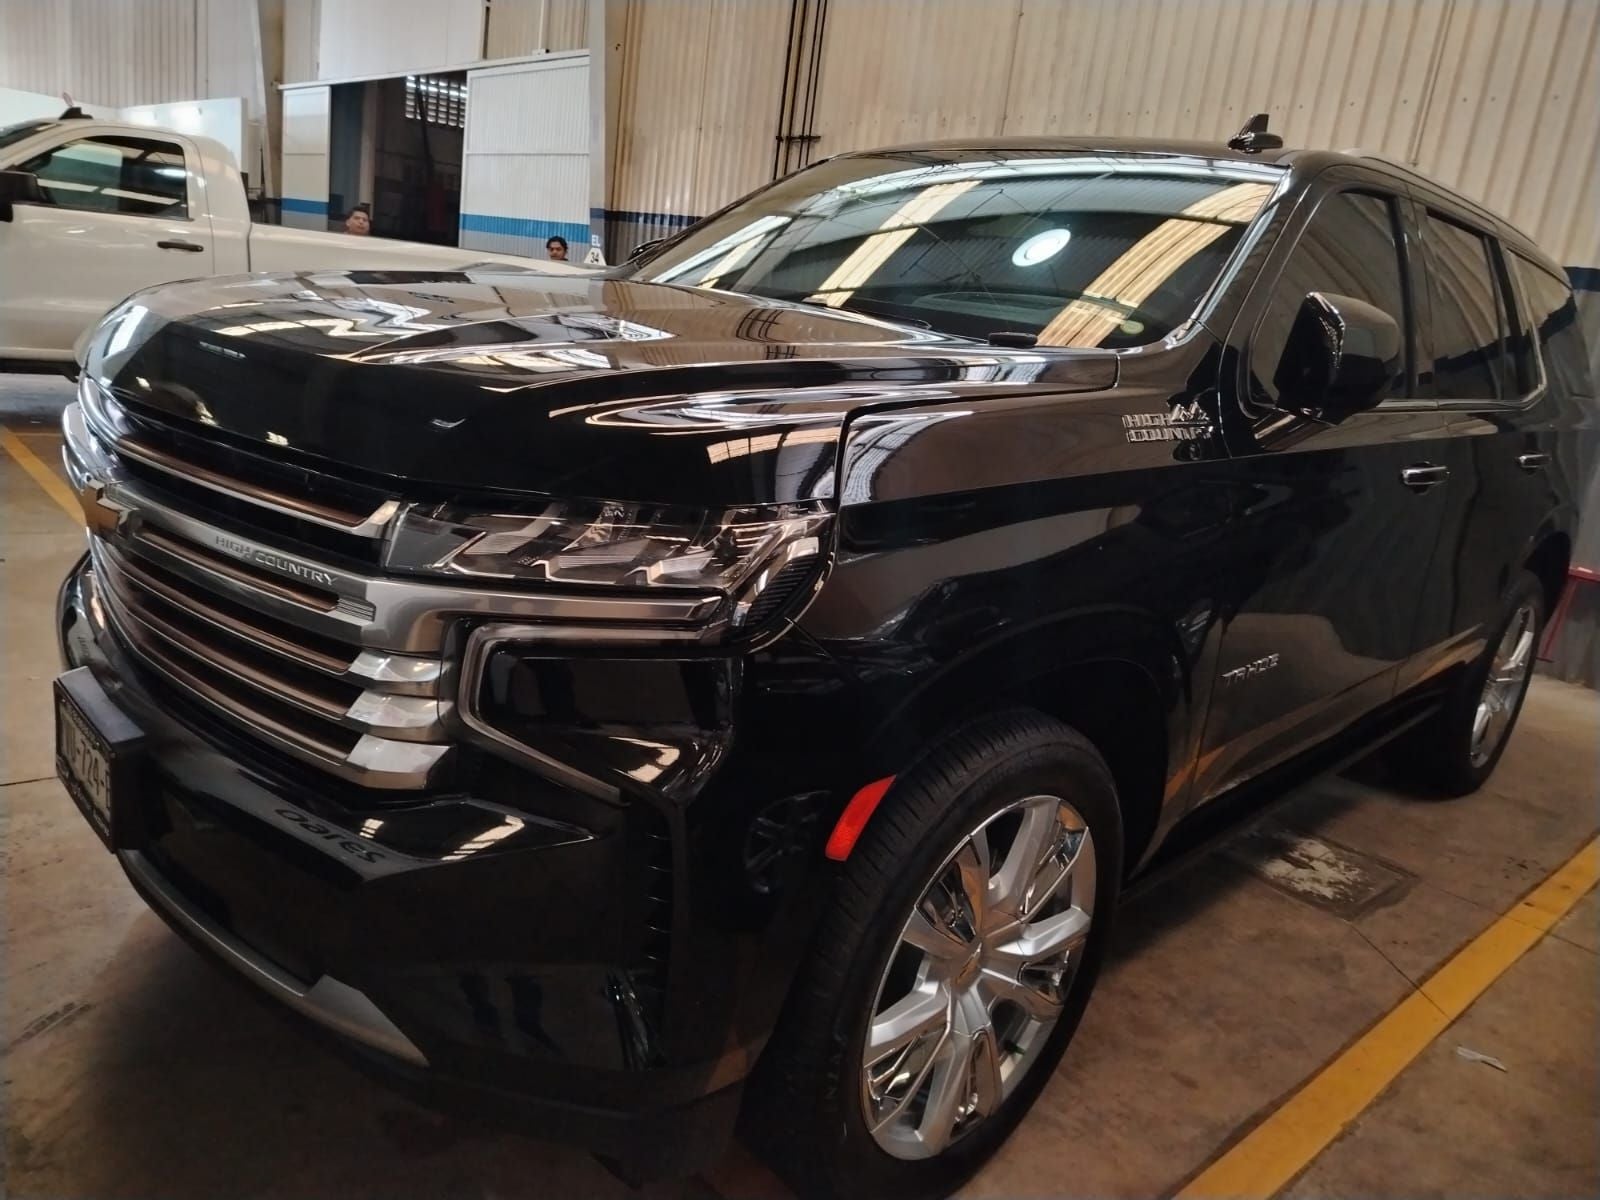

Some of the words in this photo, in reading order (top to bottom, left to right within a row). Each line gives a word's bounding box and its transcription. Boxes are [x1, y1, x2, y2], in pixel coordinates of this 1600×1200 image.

[1121, 413, 1175, 428] HIGH
[215, 535, 251, 559] HIGH
[254, 549, 339, 586] COUNTRY
[1221, 653, 1279, 688] TAHOE
